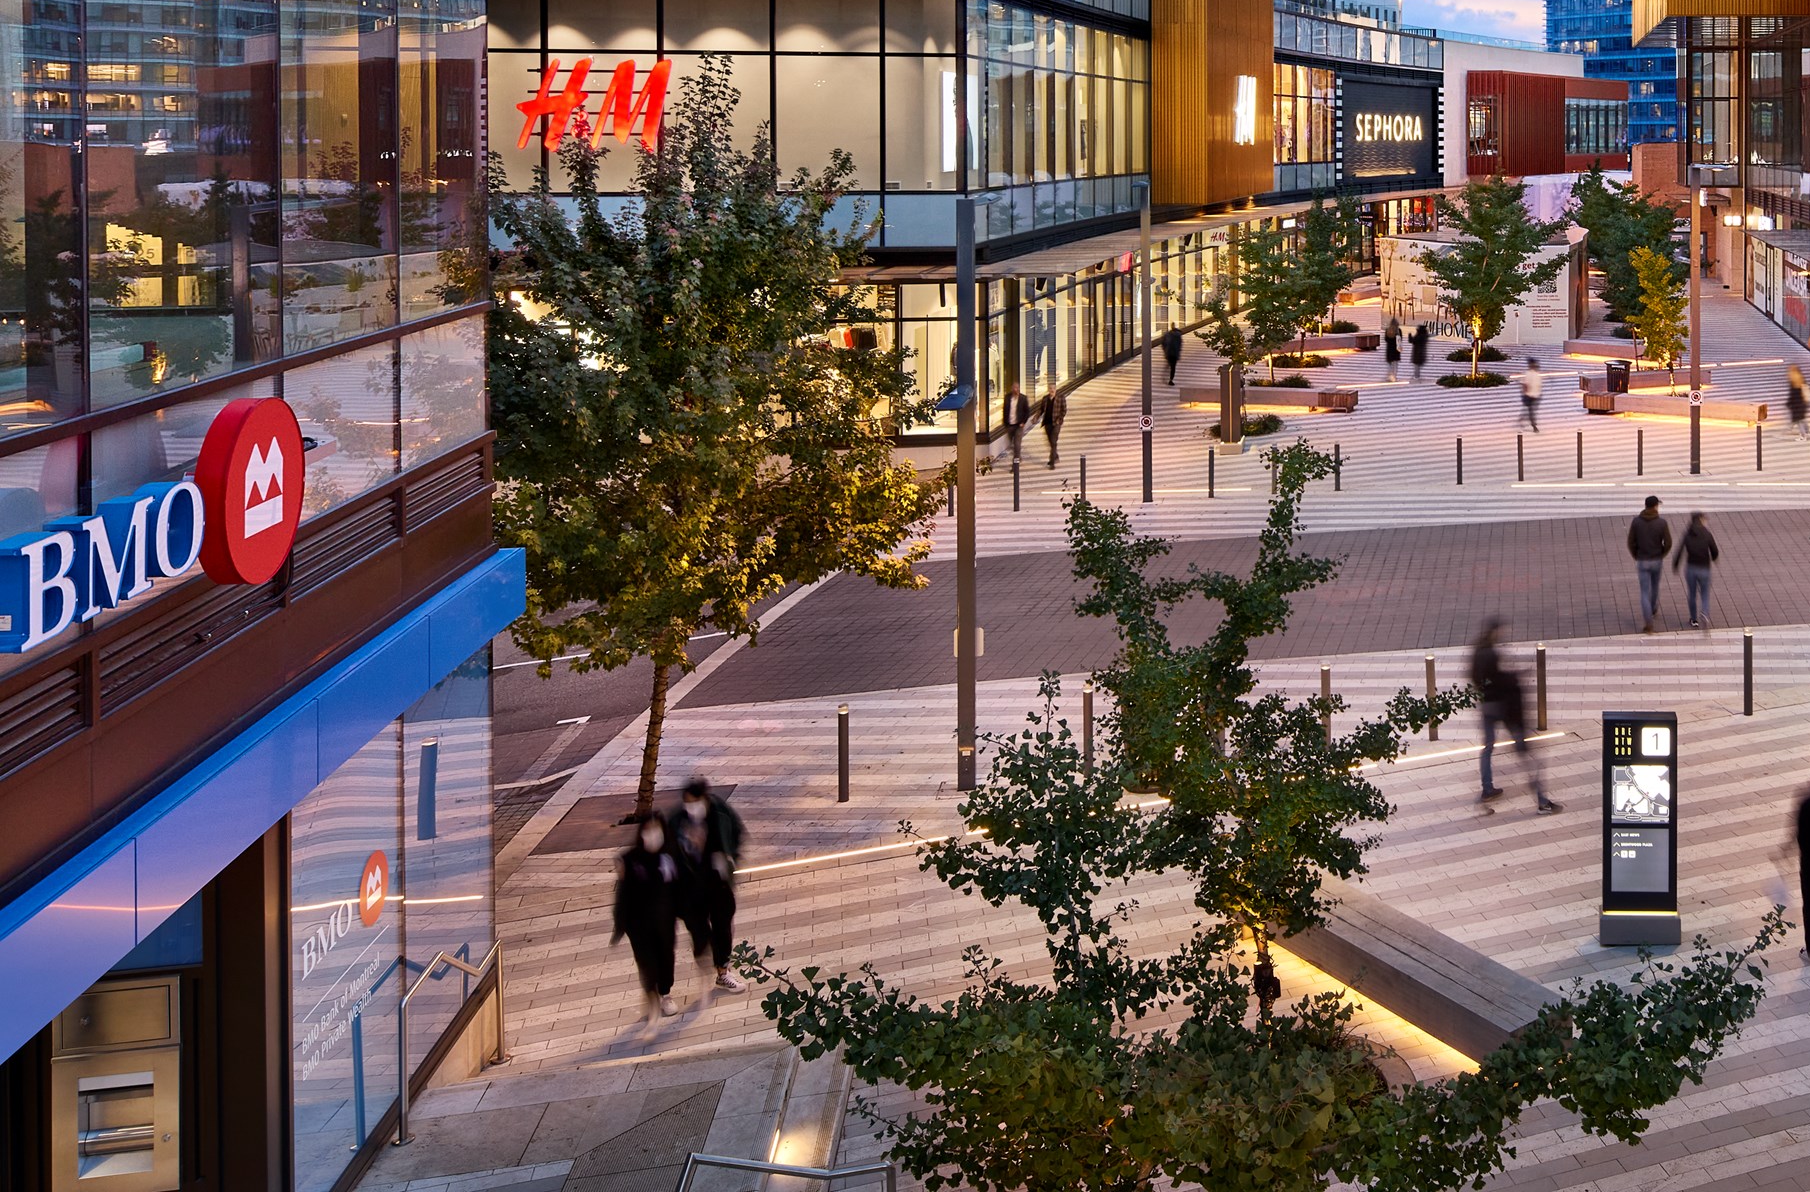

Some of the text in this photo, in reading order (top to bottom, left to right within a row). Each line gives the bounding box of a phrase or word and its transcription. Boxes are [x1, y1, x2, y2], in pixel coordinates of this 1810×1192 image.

[516, 57, 672, 153] H&M
[1355, 113, 1423, 142] SEPHORA
[21, 481, 205, 653] BMO
[1652, 733, 1659, 750] 1
[301, 899, 353, 982] BMO
[302, 951, 380, 1056] BMO Bank of Montreal
[302, 988, 373, 1082] BMO Private Wealth
